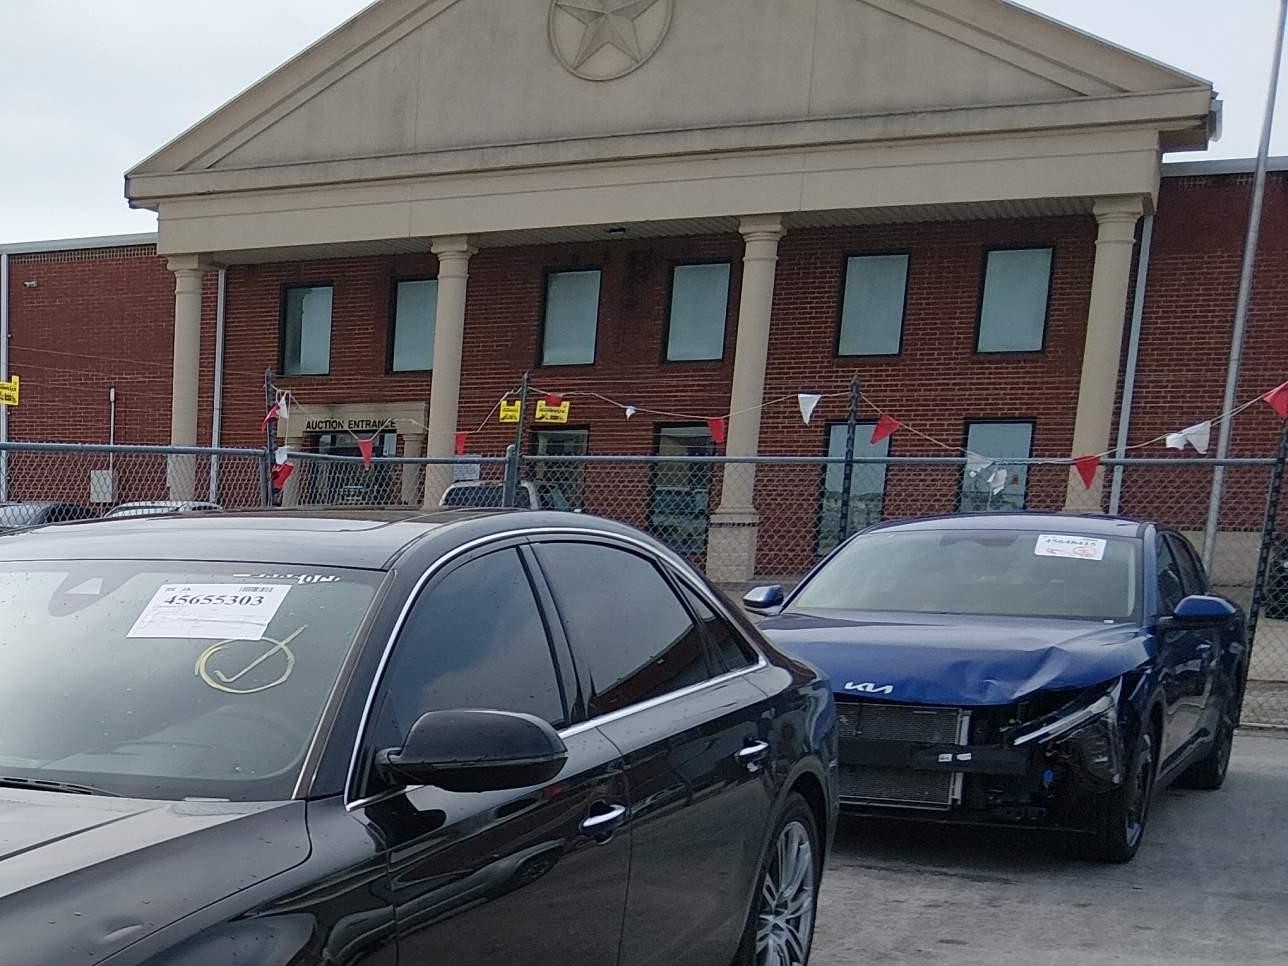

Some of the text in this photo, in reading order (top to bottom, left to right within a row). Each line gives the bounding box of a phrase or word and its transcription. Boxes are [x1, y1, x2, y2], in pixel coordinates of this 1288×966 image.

[305, 419, 396, 430] AUCTION ENTRANCE
[163, 594, 265, 606] 45655303
